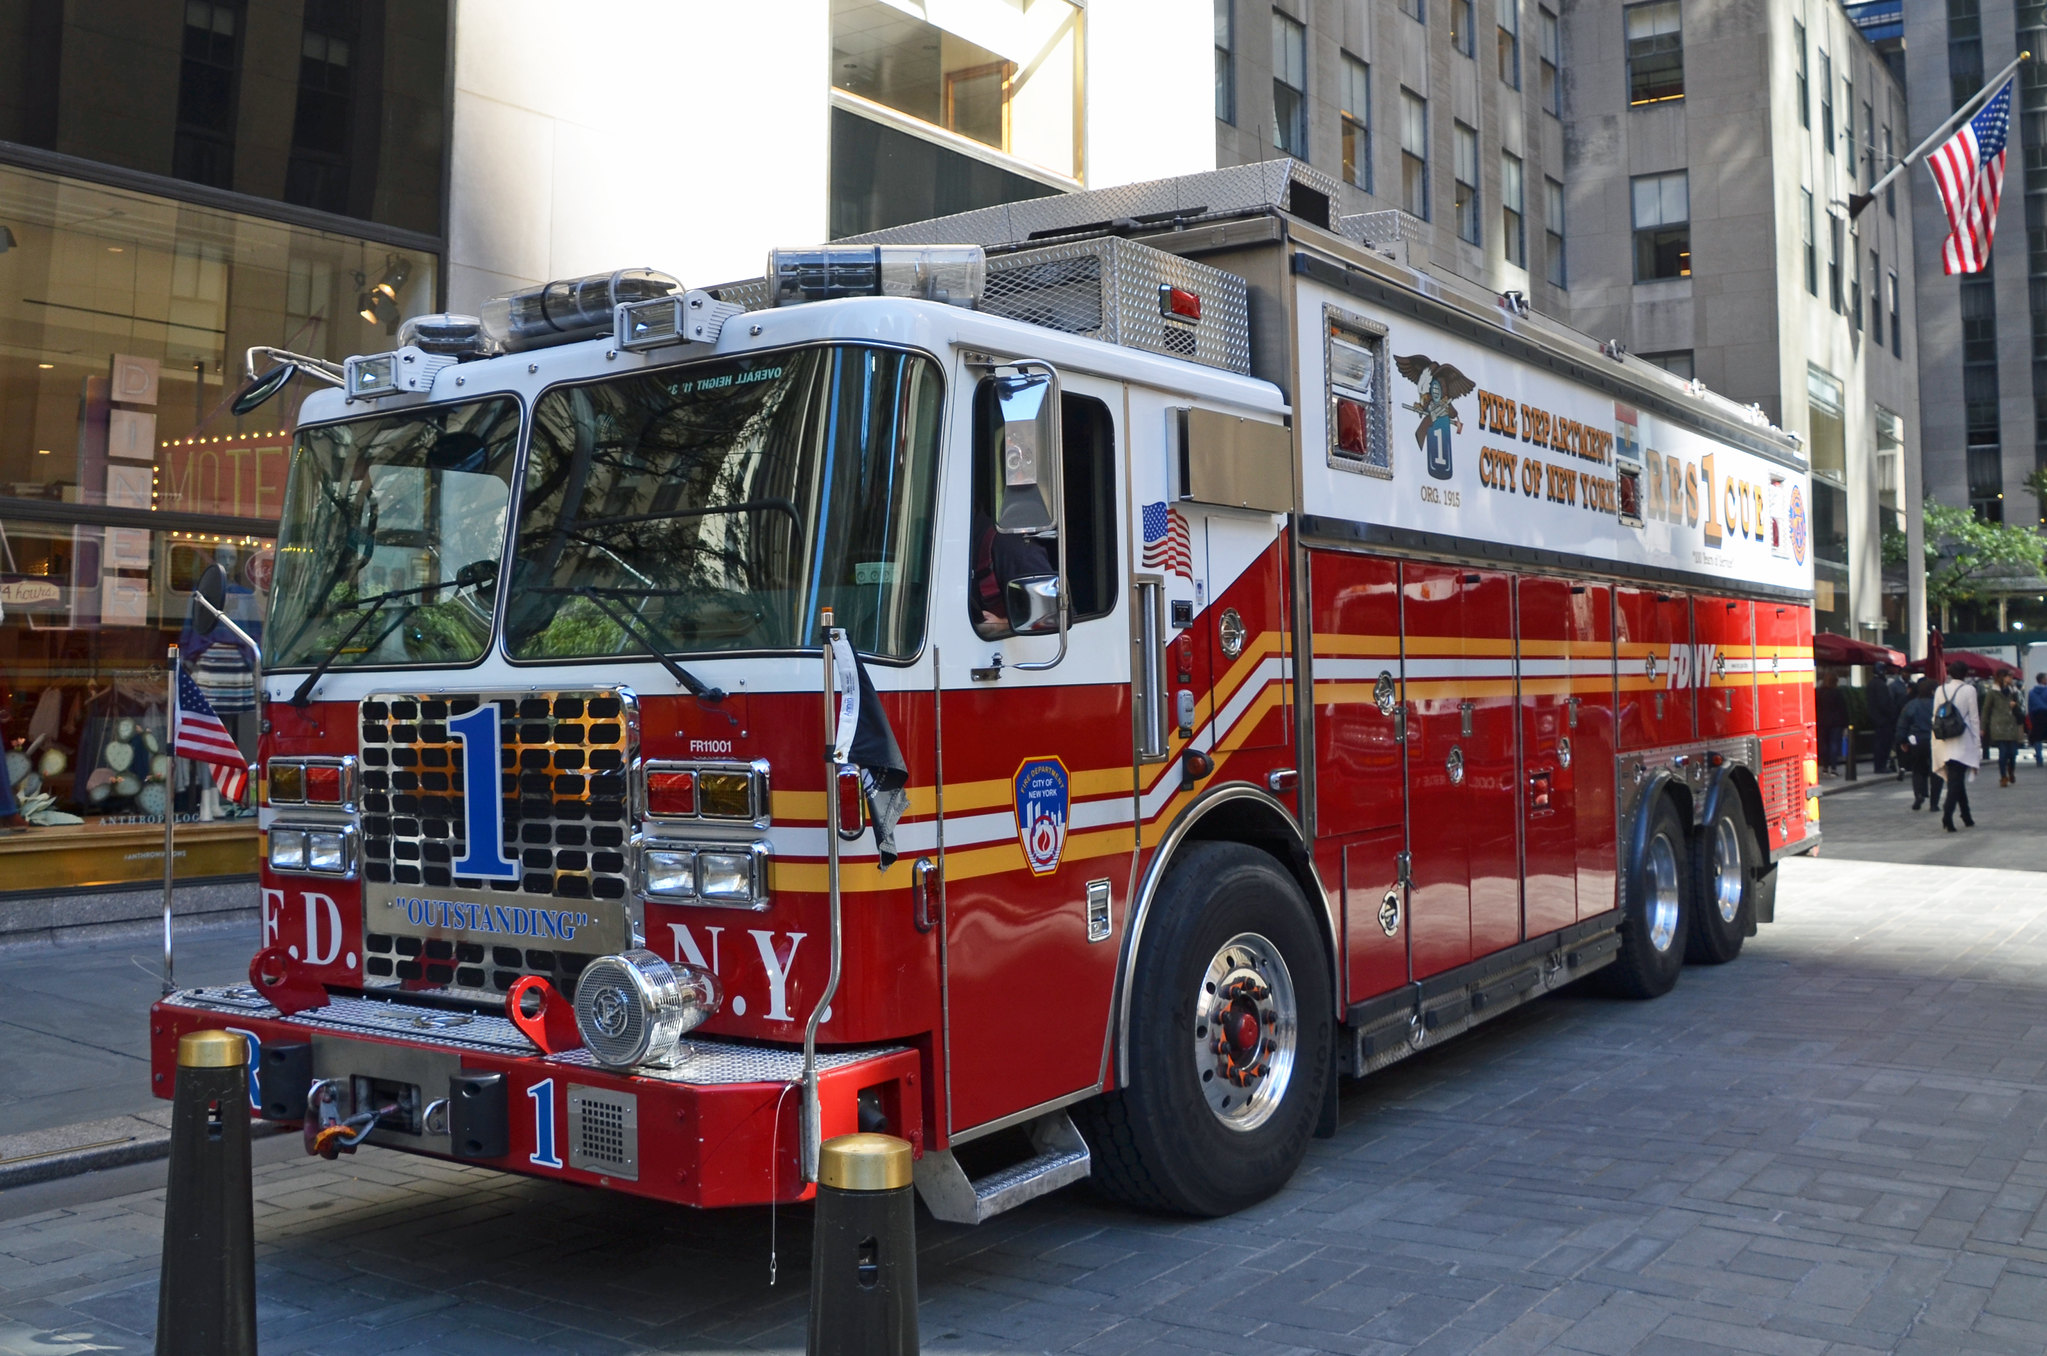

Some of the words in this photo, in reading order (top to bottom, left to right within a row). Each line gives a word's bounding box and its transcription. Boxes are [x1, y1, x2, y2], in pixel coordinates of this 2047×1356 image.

[1434, 428, 1447, 465] 1
[1478, 389, 1517, 440] FIRE
[1521, 403, 1613, 467] DEPARTMENT
[165, 445, 293, 518] MOTE
[1420, 485, 1441, 504] ORG.
[1443, 490, 1460, 508] 1915
[1479, 446, 1518, 493] CITY
[1522, 457, 1542, 499] OF
[1546, 463, 1577, 506] NEW
[1580, 472, 1617, 515] YORK
[1666, 643, 1716, 690] FDNY
[690, 740, 732, 753] FR11001
[446, 702, 520, 881] 1
[1028, 790, 1041, 799] NEW
[1042, 789, 1057, 797] YORK
[1031, 766, 1064, 788] DEPARTMENT
[1032, 779, 1044, 788] CITY
[1045, 778, 1053, 787] OF
[396, 897, 587, 940] "OUTSTANDING"
[526, 1078, 563, 1169] 1
